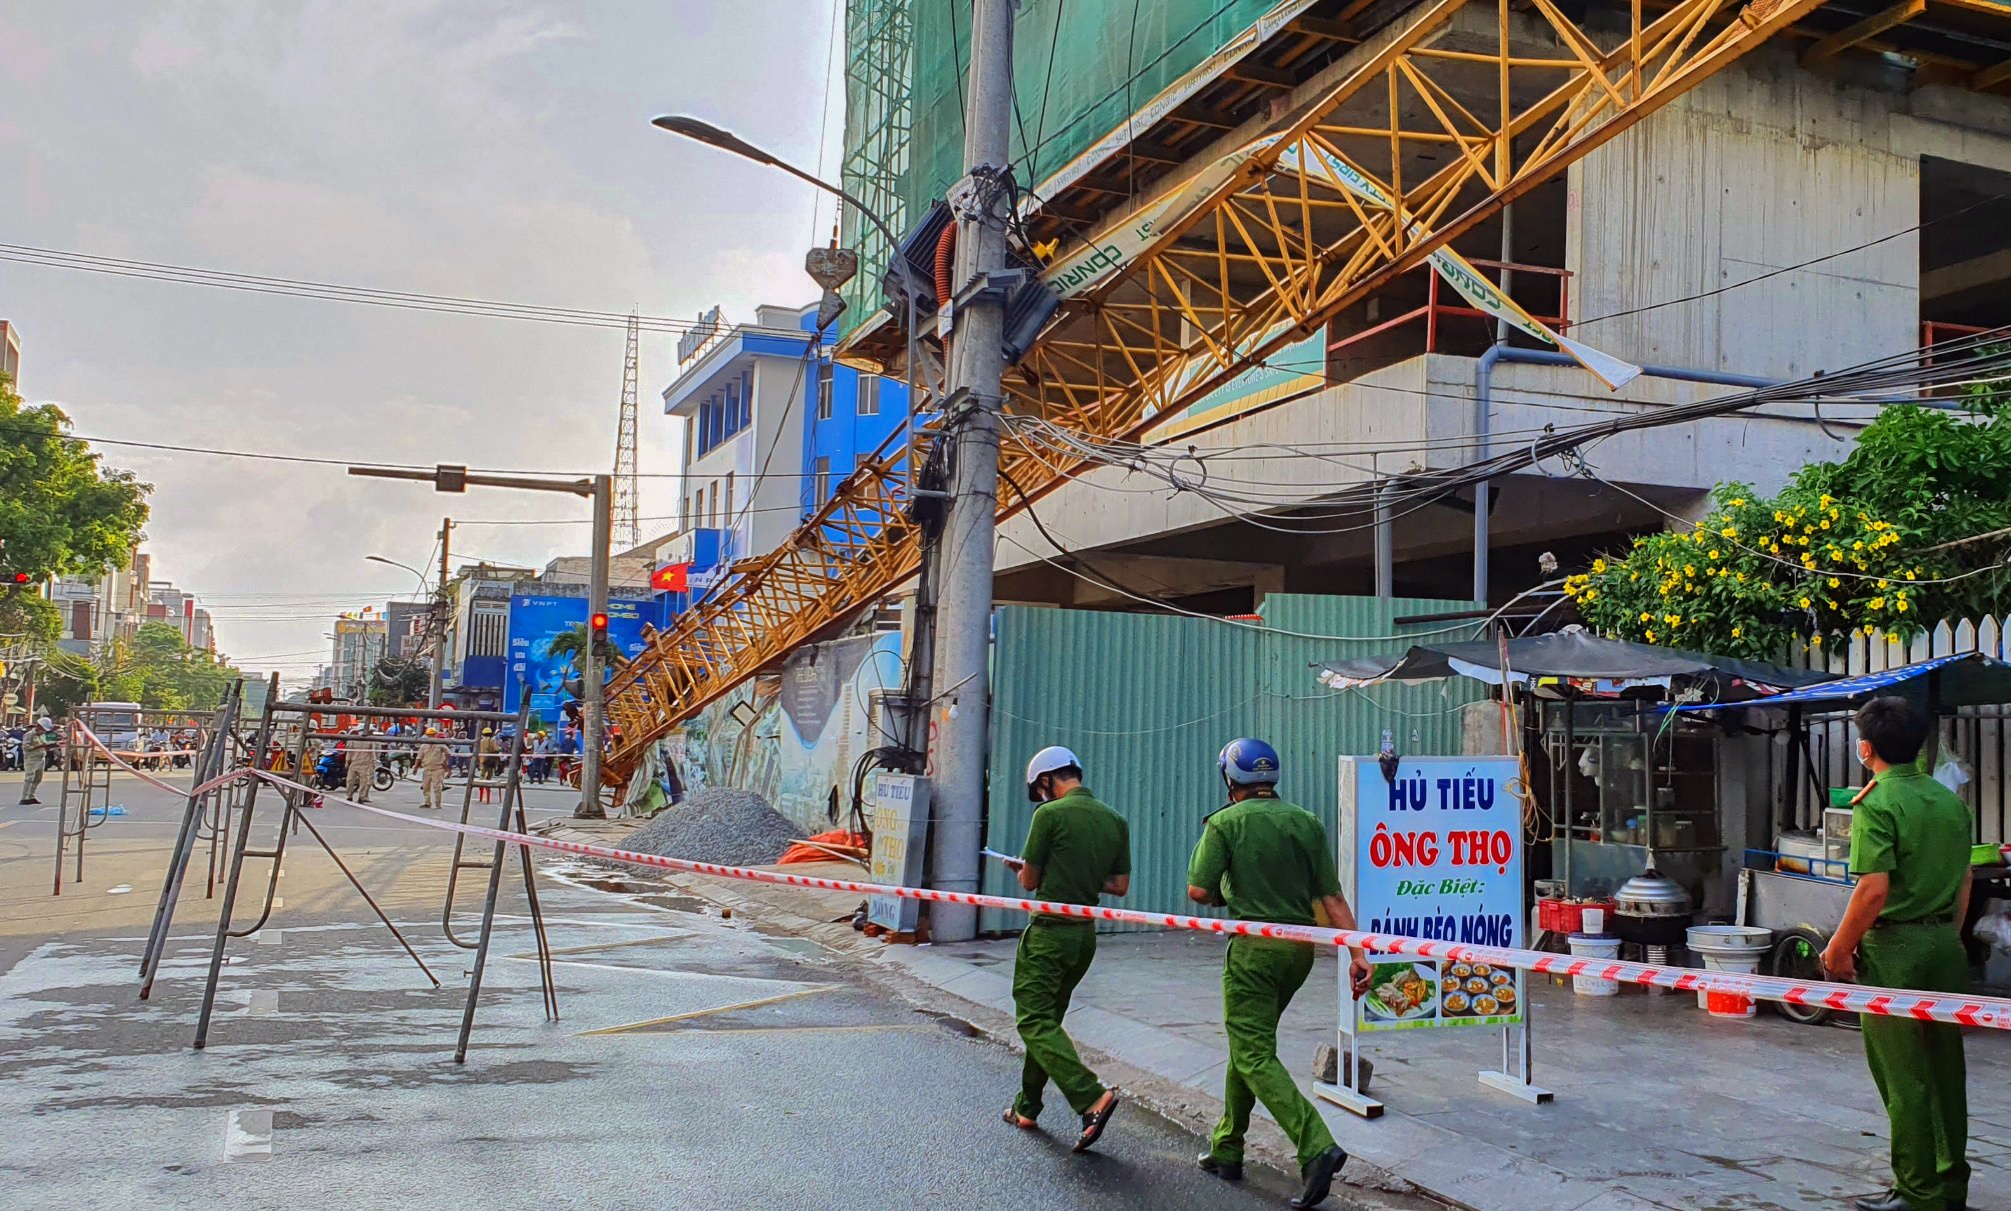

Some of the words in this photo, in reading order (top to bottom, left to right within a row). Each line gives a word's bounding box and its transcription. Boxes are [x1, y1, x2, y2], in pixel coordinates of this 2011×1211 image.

[1047, 244, 1123, 295] CONRIC
[1389, 769, 1427, 811] HỦ
[1437, 766, 1494, 811] TIẾU
[1369, 821, 1440, 868] ÔNG
[1447, 829, 1513, 876] THỌ
[1396, 879, 1436, 900] Đặc
[1439, 876, 1486, 898] Biệt:
[1461, 902, 1513, 948] NÓNG
